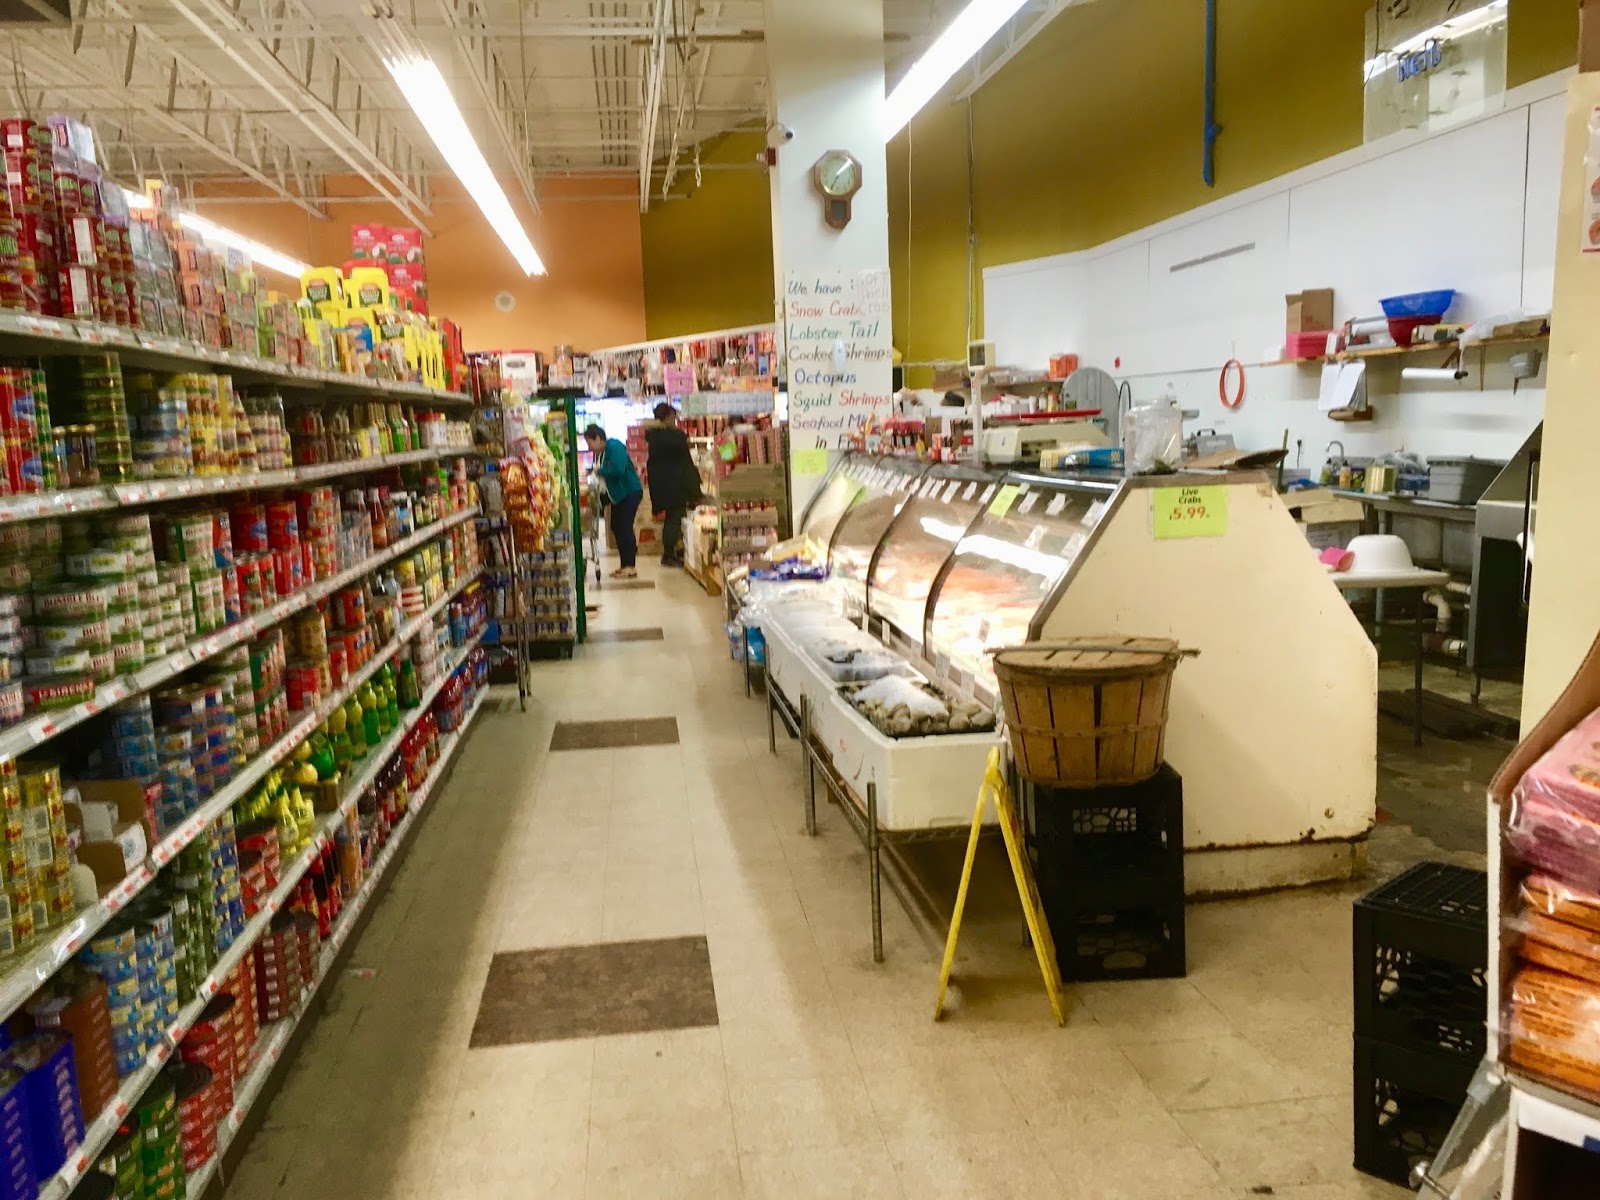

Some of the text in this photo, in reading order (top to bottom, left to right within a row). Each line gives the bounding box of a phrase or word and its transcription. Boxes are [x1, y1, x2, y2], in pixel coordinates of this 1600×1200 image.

[788, 280, 807, 295] We
[814, 278, 842, 294] have
[789, 300, 859, 318] Snow Crab
[789, 320, 880, 341] Lobster Tail
[794, 367, 857, 387] Octopus
[792, 389, 891, 413] Squid Shrimps
[791, 413, 844, 431] Seafood
[815, 434, 828, 449] in
[1178, 496, 1202, 504] Crabs
[1181, 488, 1199, 496] Live
